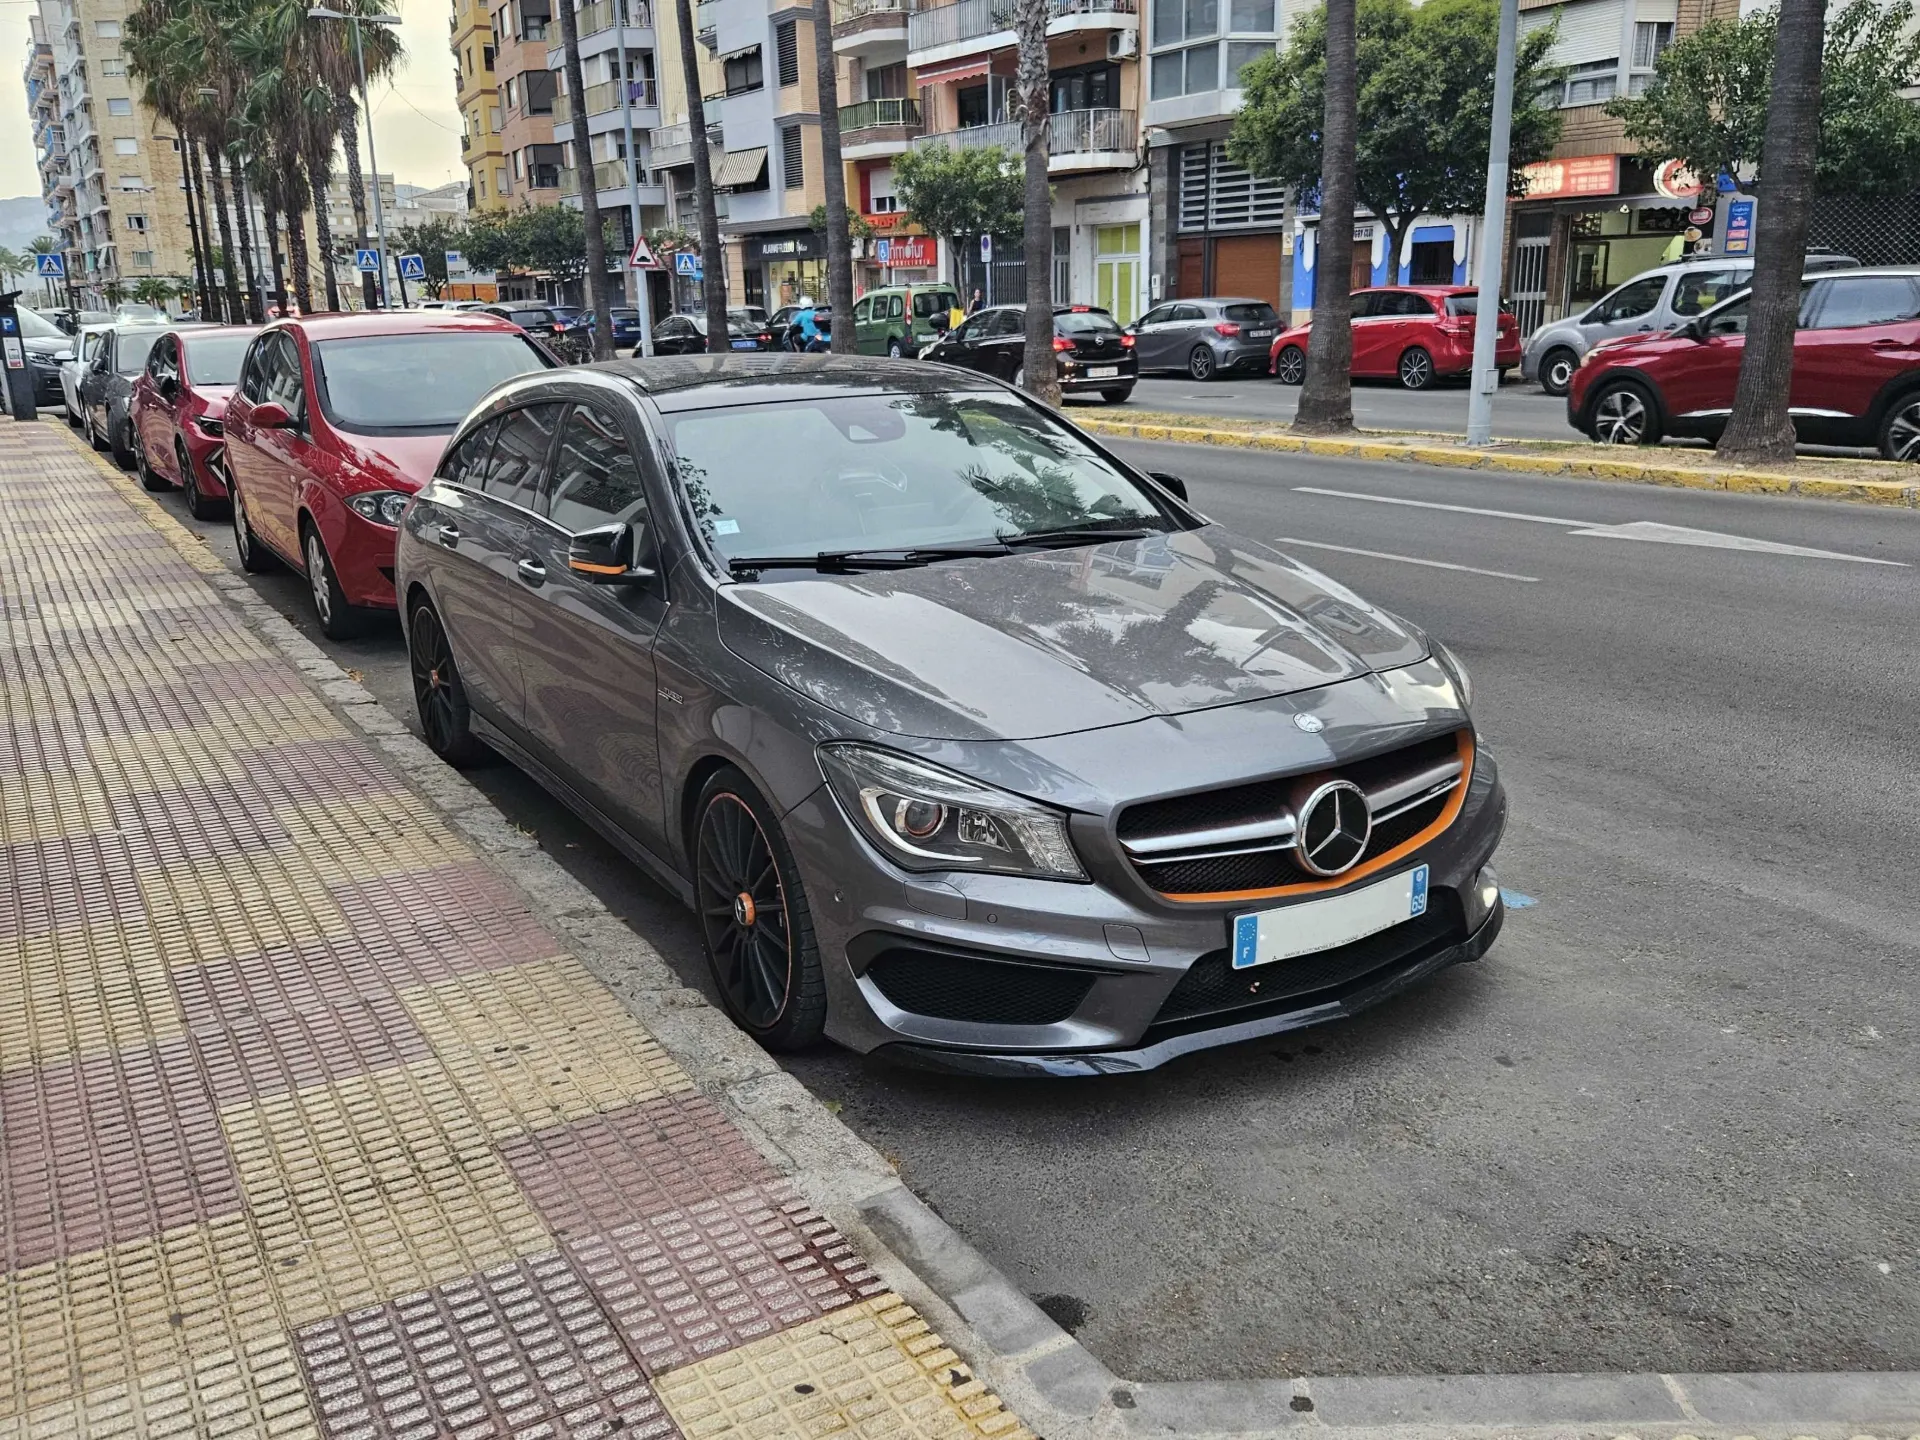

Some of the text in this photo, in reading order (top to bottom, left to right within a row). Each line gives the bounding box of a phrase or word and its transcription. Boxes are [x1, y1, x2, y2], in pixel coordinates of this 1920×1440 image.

[2, 318, 13, 330] P
[1412, 893, 1424, 912] 69
[1243, 947, 1251, 959] F
